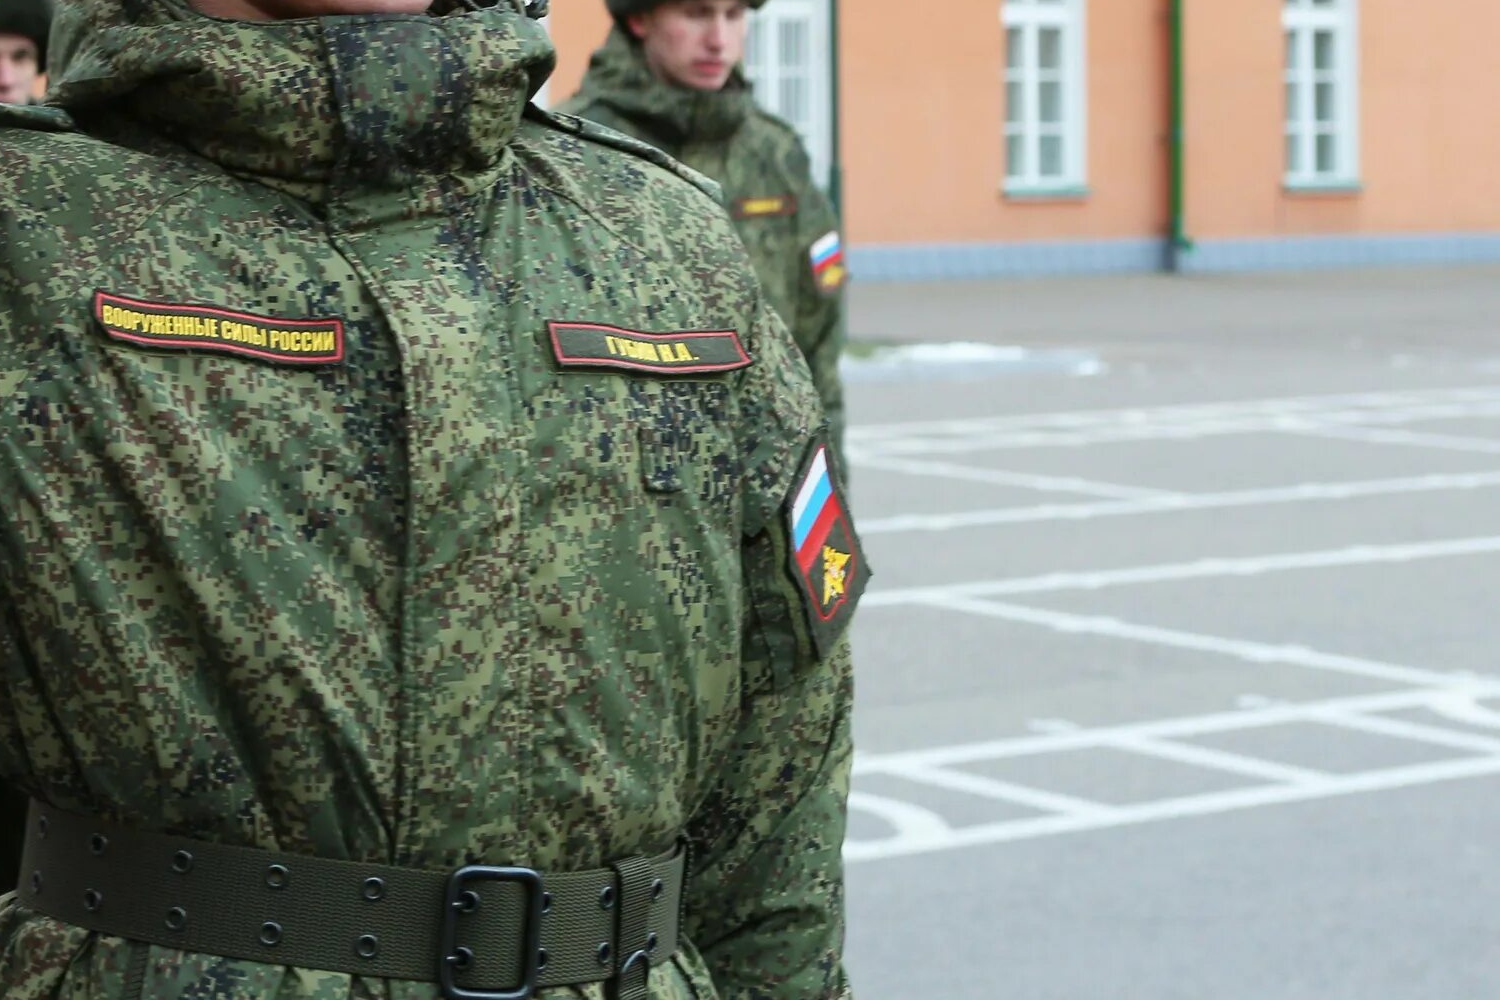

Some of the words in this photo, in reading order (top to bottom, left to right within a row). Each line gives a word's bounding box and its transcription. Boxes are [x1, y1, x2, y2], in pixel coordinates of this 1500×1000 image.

[102, 305, 219, 338] ВООРУЖЕННЫЕ
[220, 320, 267, 347] СИЛЫ
[269, 330, 335, 352] РОССИИ
